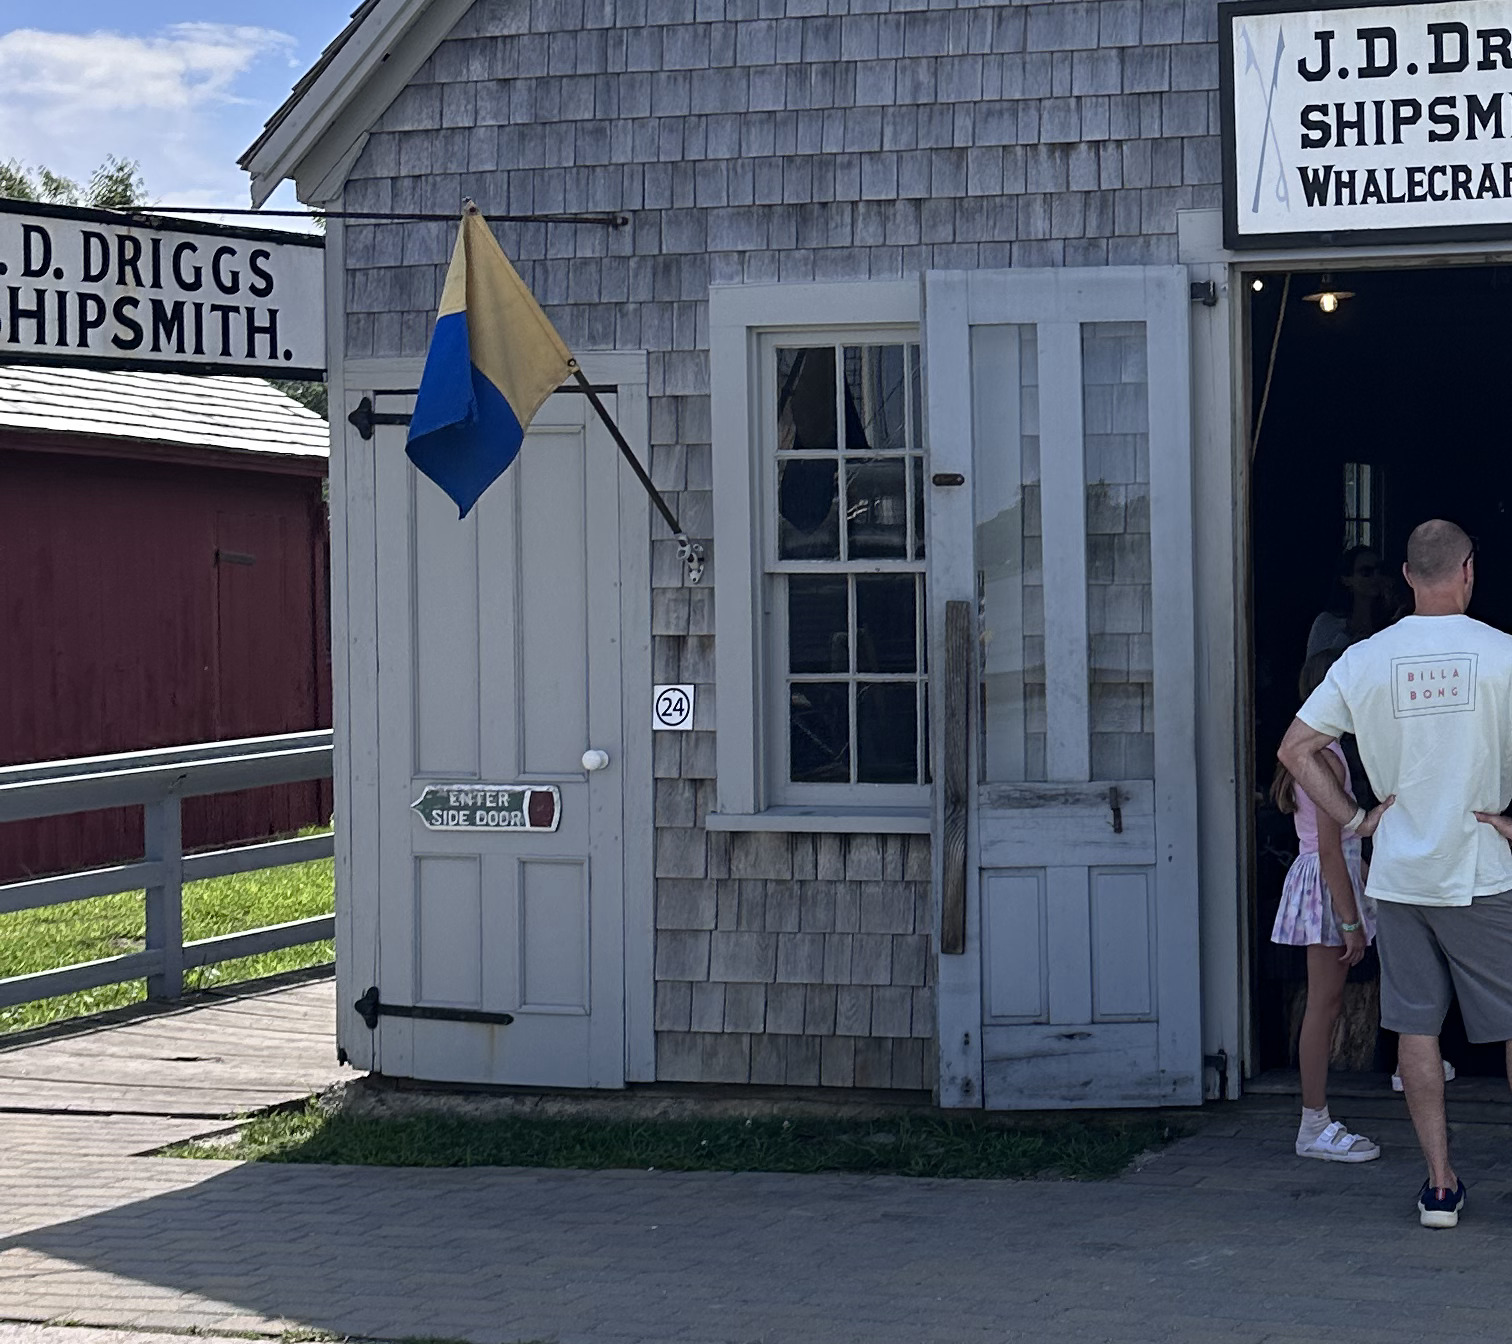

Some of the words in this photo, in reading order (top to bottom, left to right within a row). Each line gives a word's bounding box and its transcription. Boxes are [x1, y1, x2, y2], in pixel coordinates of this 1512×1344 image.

[80, 229, 275, 299] DRIGGS
[0, 285, 294, 361] HIPSMITH.
[1410, 687, 1458, 700] BONG
[661, 697, 685, 717] 24
[449, 791, 510, 807] ENTER
[431, 809, 470, 826] SIDE
[475, 810, 524, 826] DOOR
